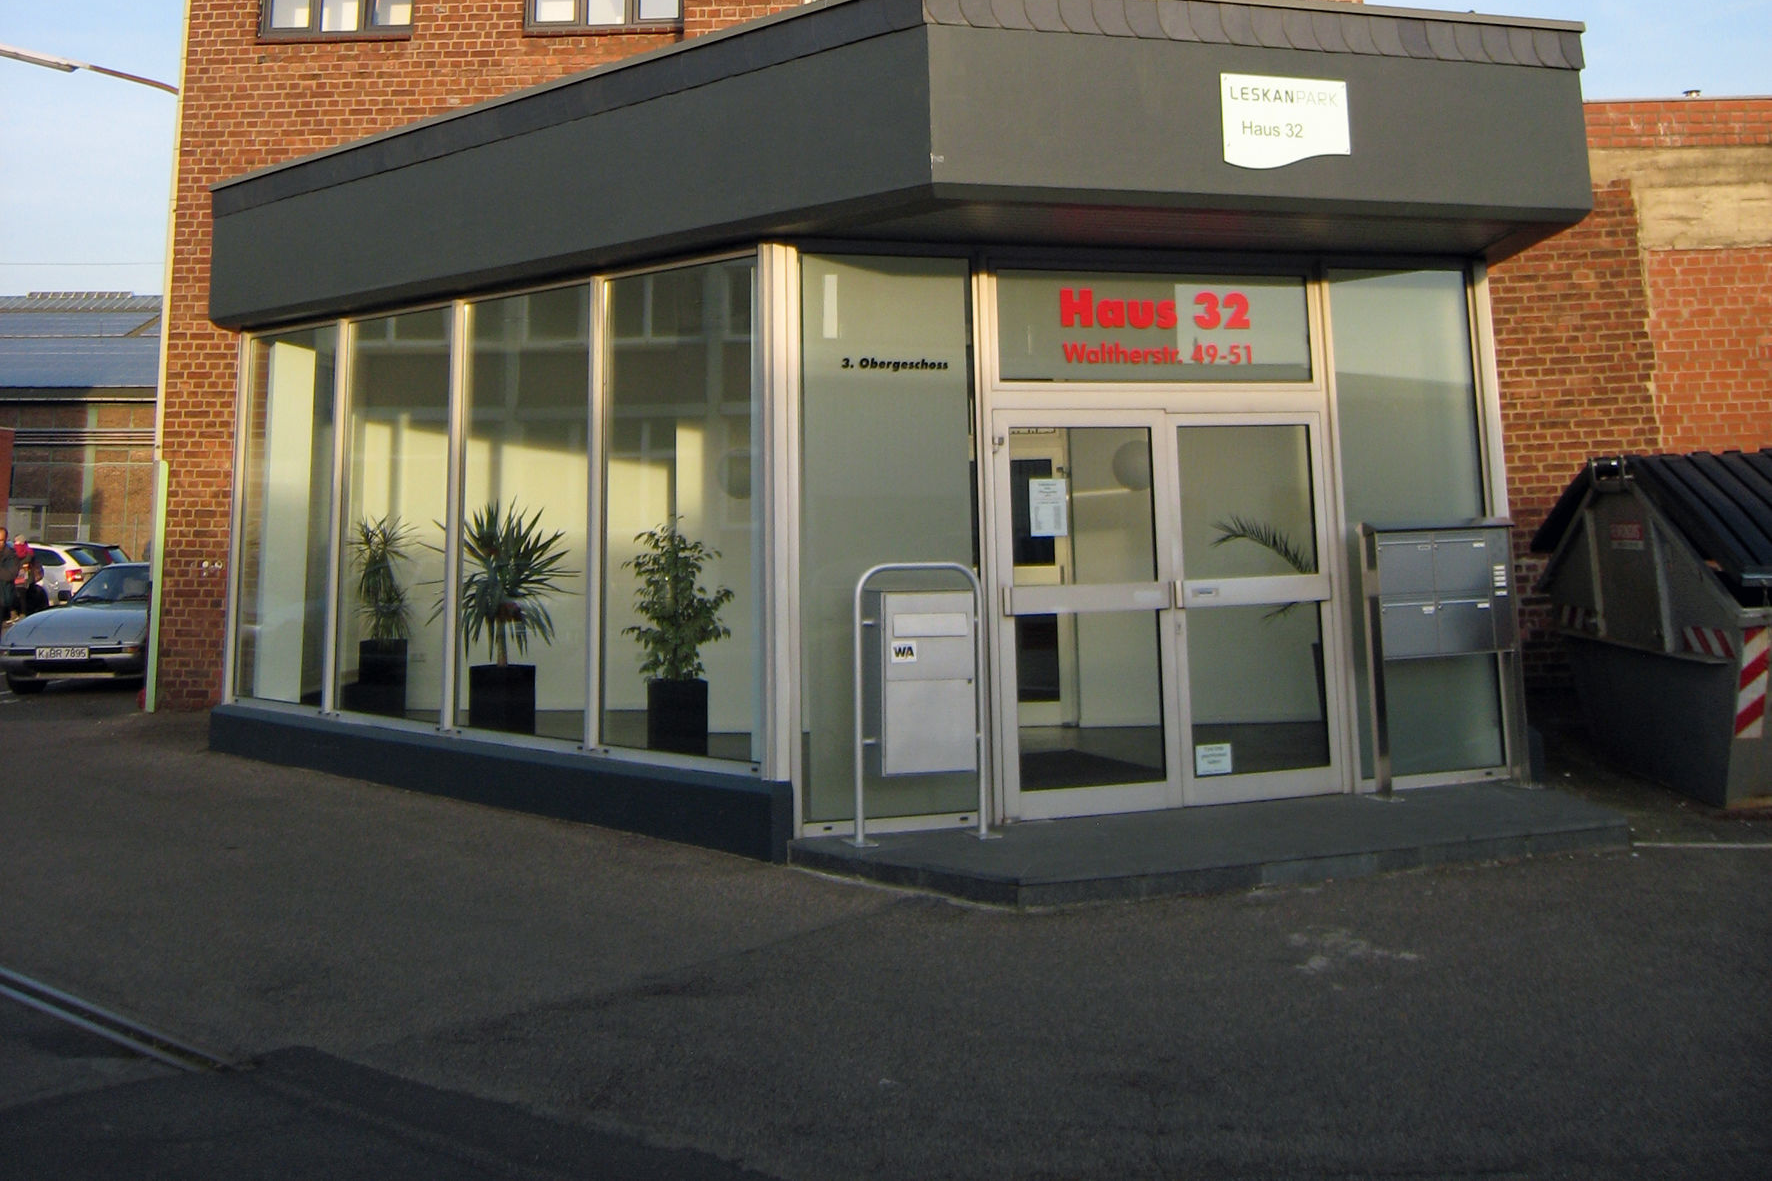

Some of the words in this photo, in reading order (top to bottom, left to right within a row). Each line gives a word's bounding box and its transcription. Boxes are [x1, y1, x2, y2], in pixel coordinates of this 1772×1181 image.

[1241, 120, 1281, 137] Haus
[1285, 123, 1304, 138] 32
[1060, 288, 1178, 328] Haus
[1193, 292, 1251, 330] 32
[1062, 341, 1183, 364] Waltherstr.
[1191, 344, 1253, 365] 49-51
[841, 357, 854, 369] 3.
[859, 357, 949, 372] Obergeschoss
